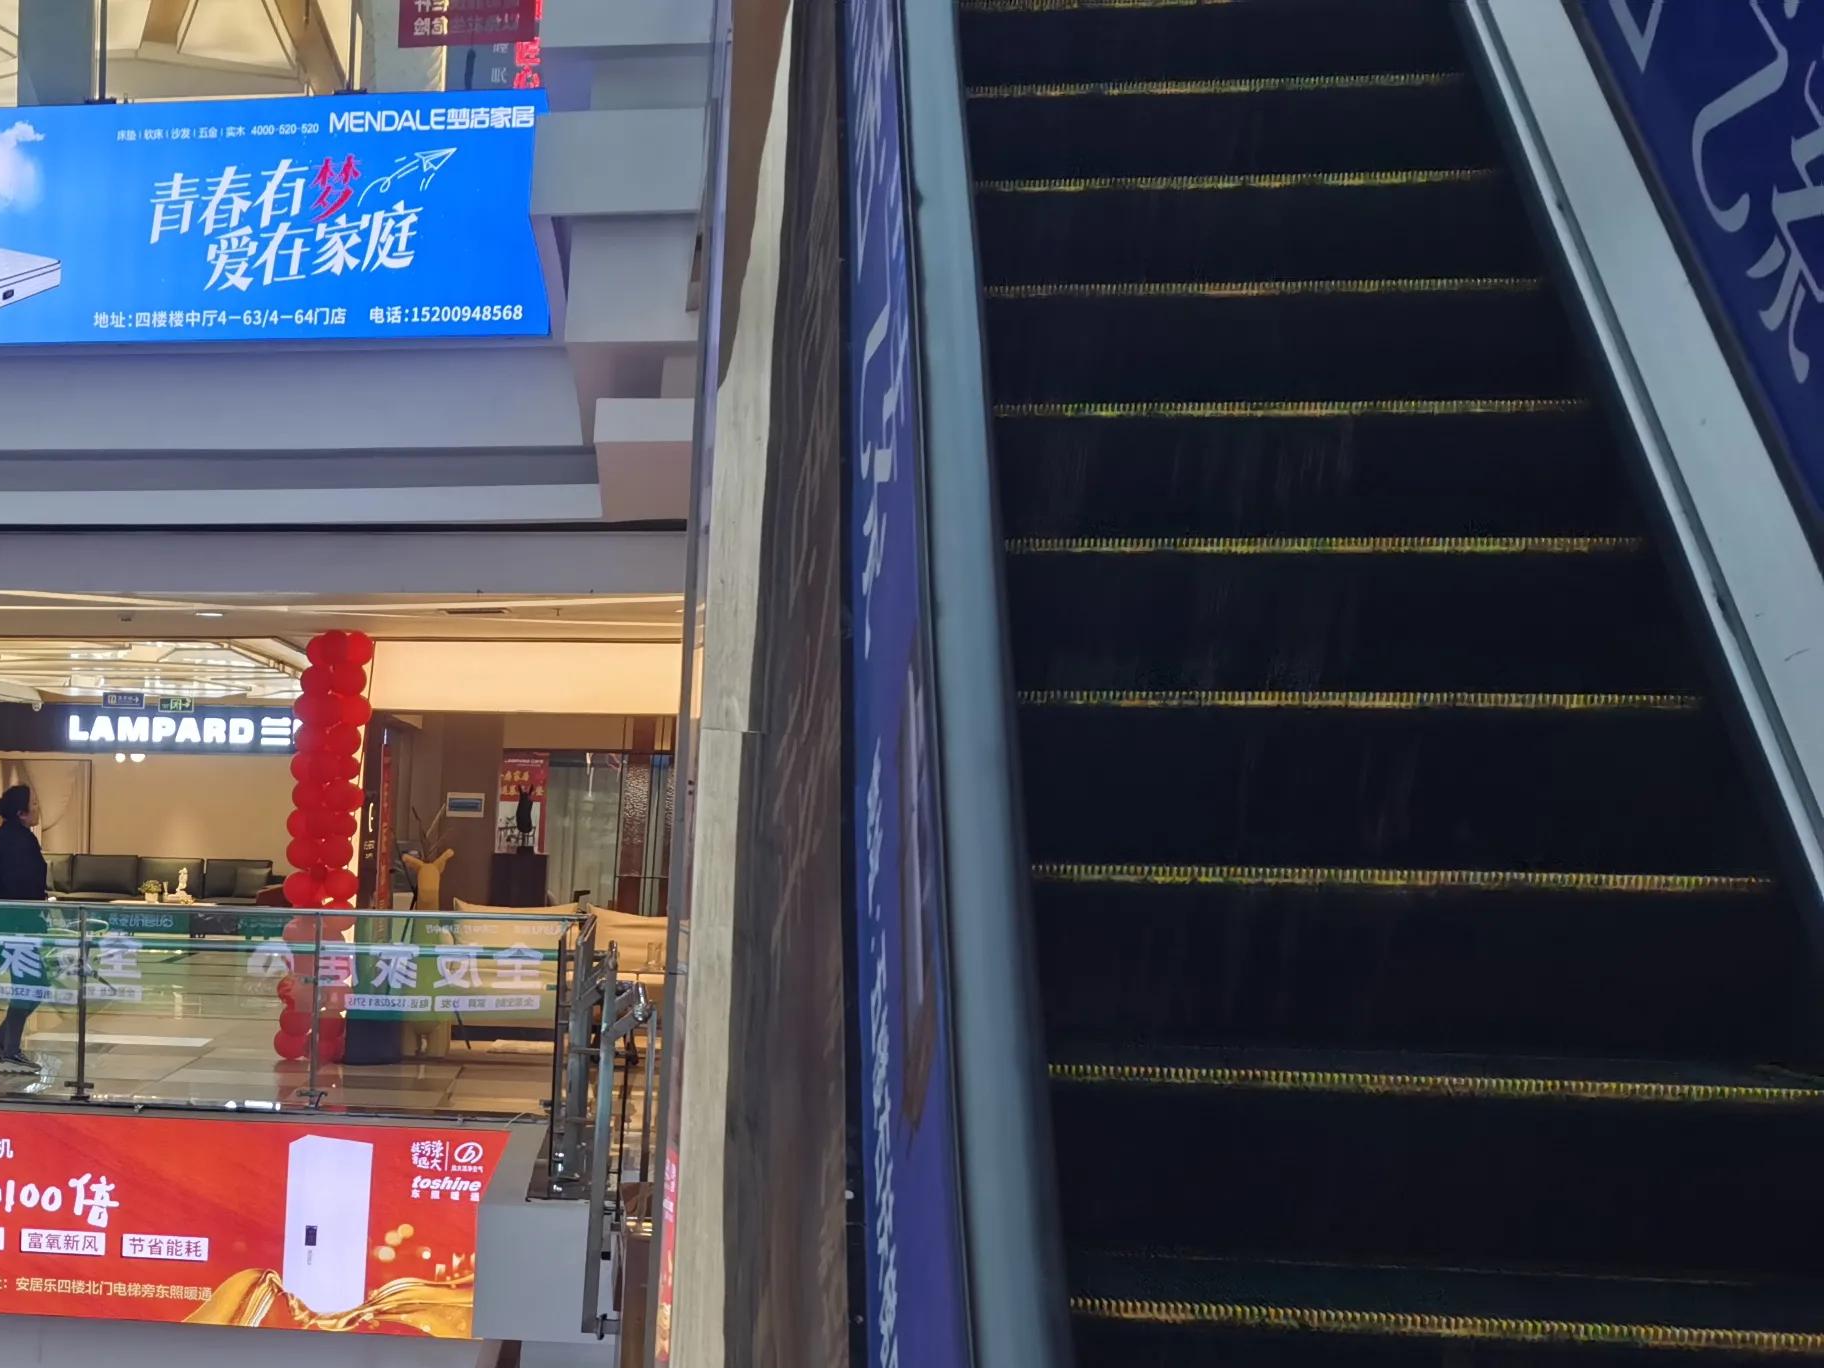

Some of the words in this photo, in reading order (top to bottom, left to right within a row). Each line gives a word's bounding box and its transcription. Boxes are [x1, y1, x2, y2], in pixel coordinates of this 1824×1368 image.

[199, 127, 218, 138] 五金
[150, 154, 361, 243] 青春有梦
[205, 200, 420, 291] 爱在家庭
[68, 715, 255, 743] LAMPARD
[412, 1176, 482, 1191] toshine
[28, 1232, 98, 1252] 富氧新风
[129, 1238, 202, 1258] 节省能耗
